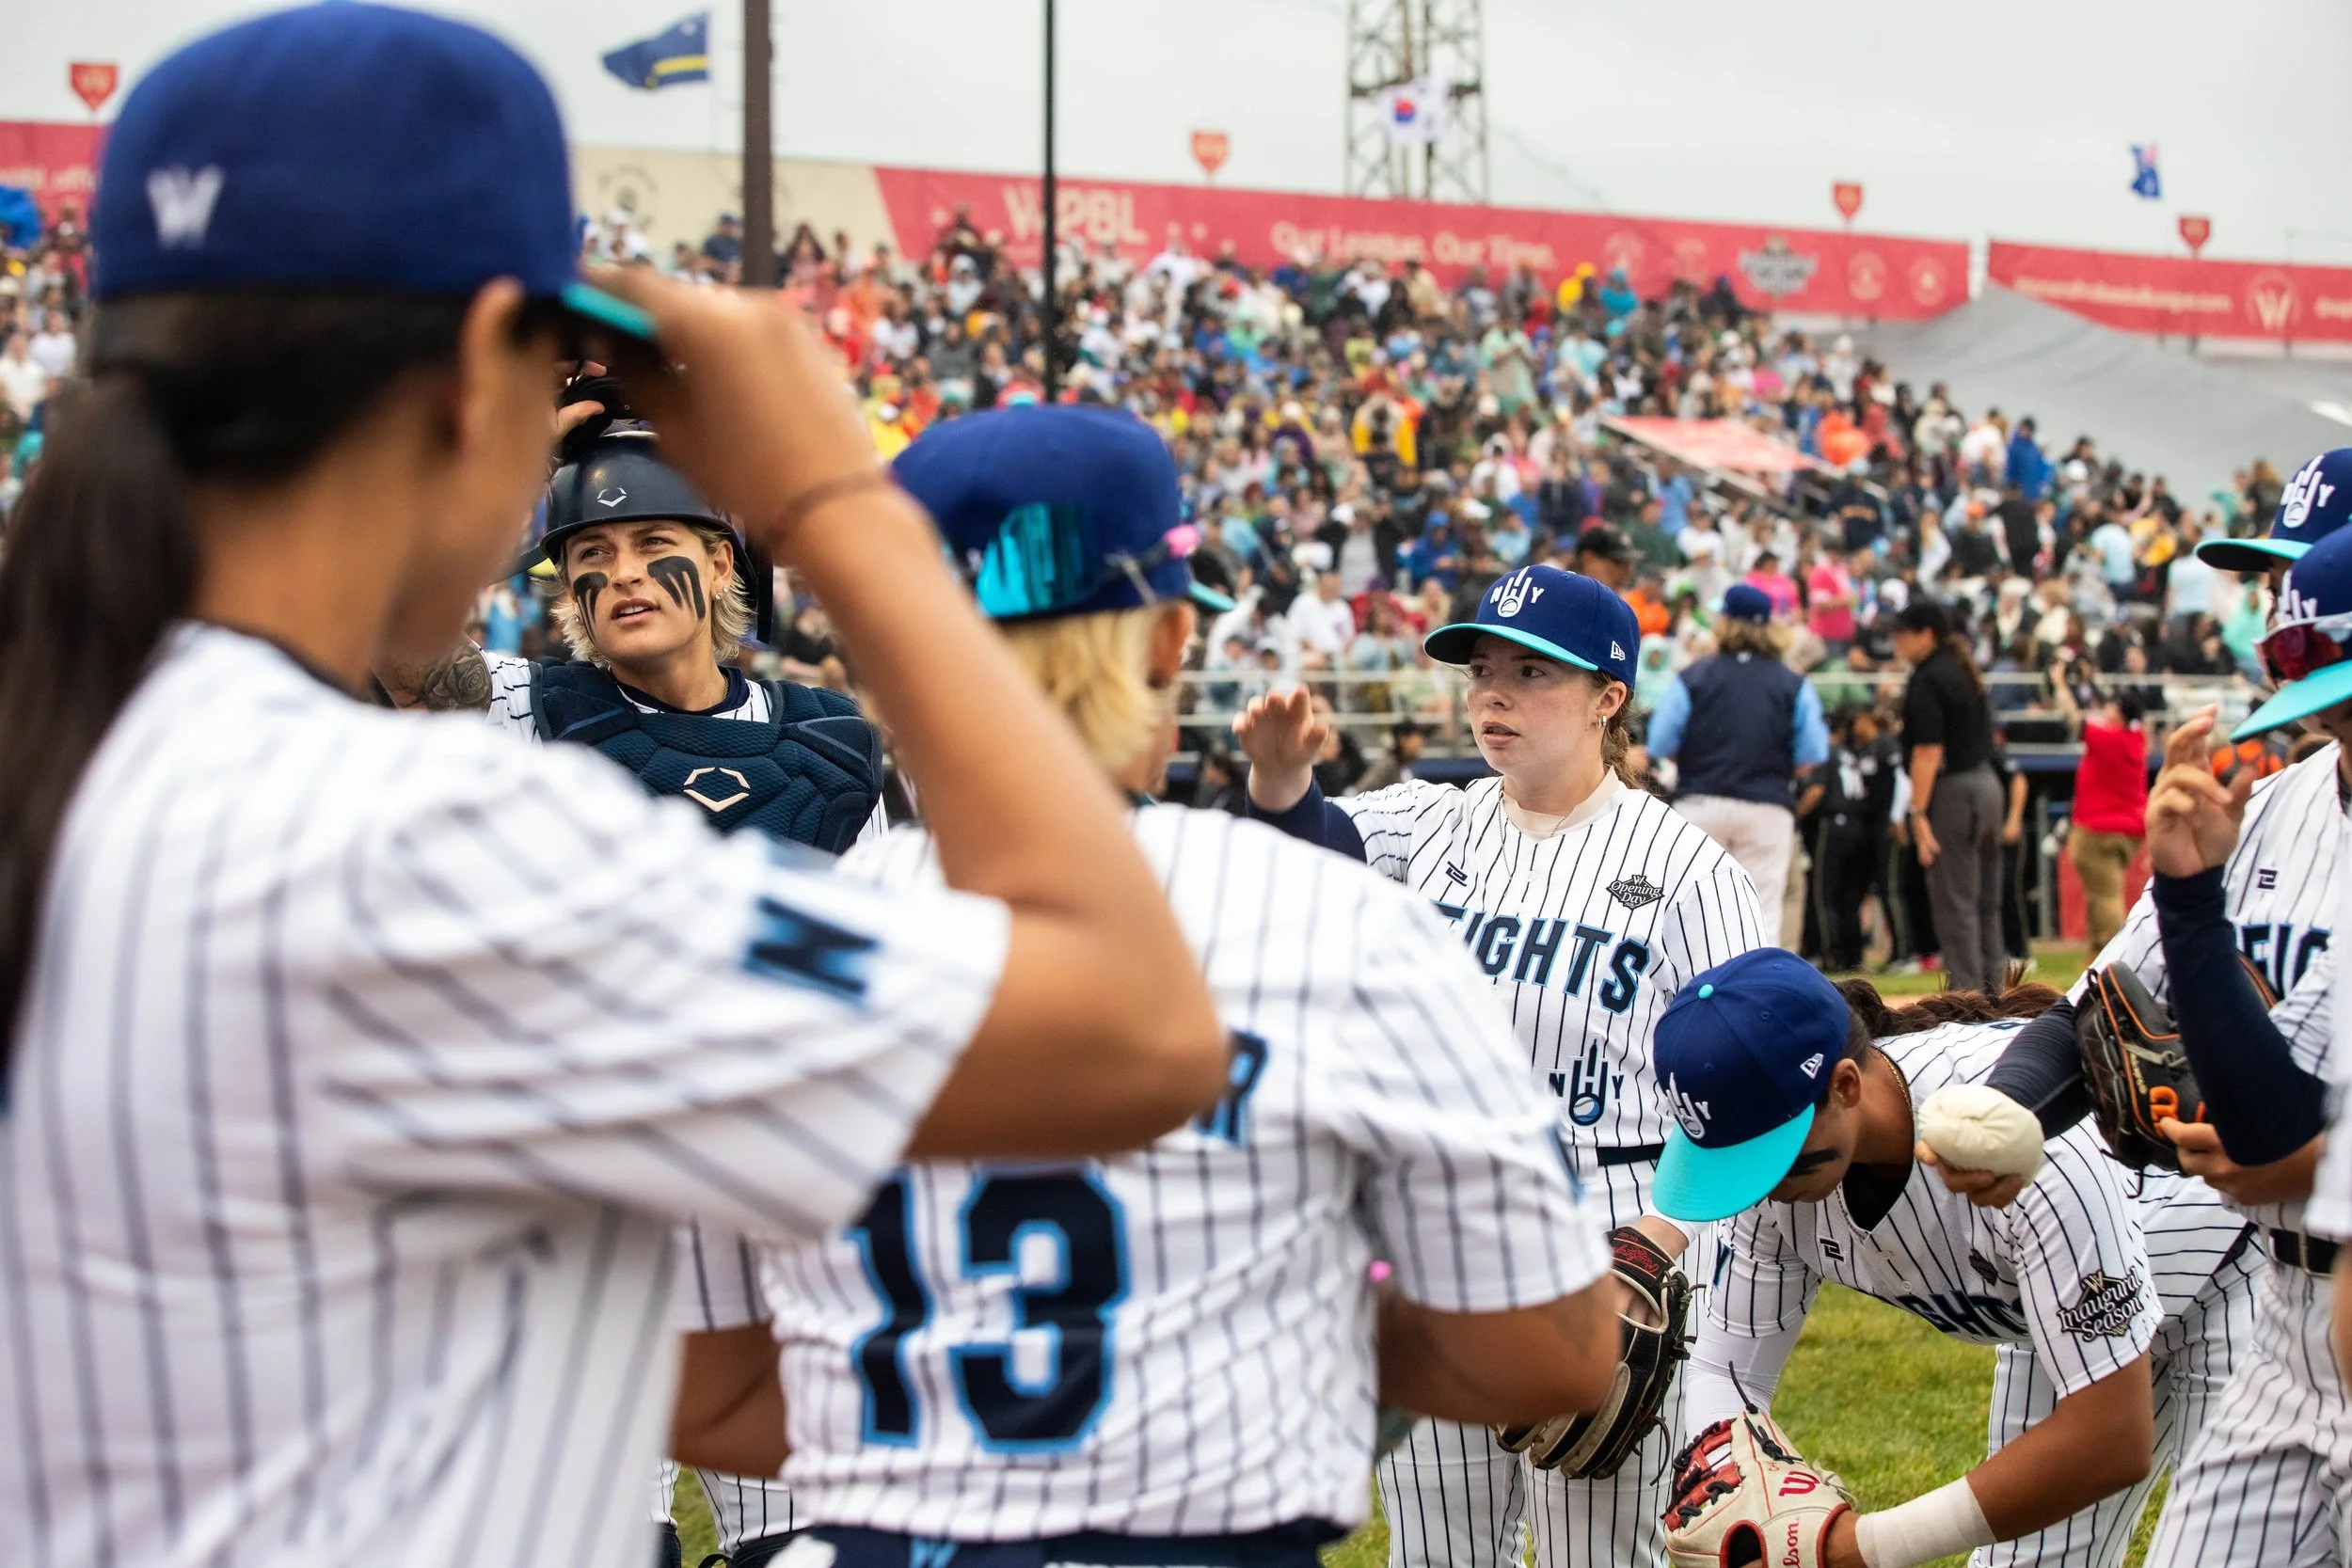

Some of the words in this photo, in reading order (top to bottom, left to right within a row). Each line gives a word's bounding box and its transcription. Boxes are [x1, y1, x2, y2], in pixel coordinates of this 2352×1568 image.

[1611, 881, 1662, 898] Opening
[1622, 893, 1646, 907] Day
[1430, 899, 1650, 1016] IGHTS
[843, 1163, 1130, 1454] 13
[2058, 1266, 2143, 1331] Inaugural
[2080, 1296, 2145, 1341] Season
